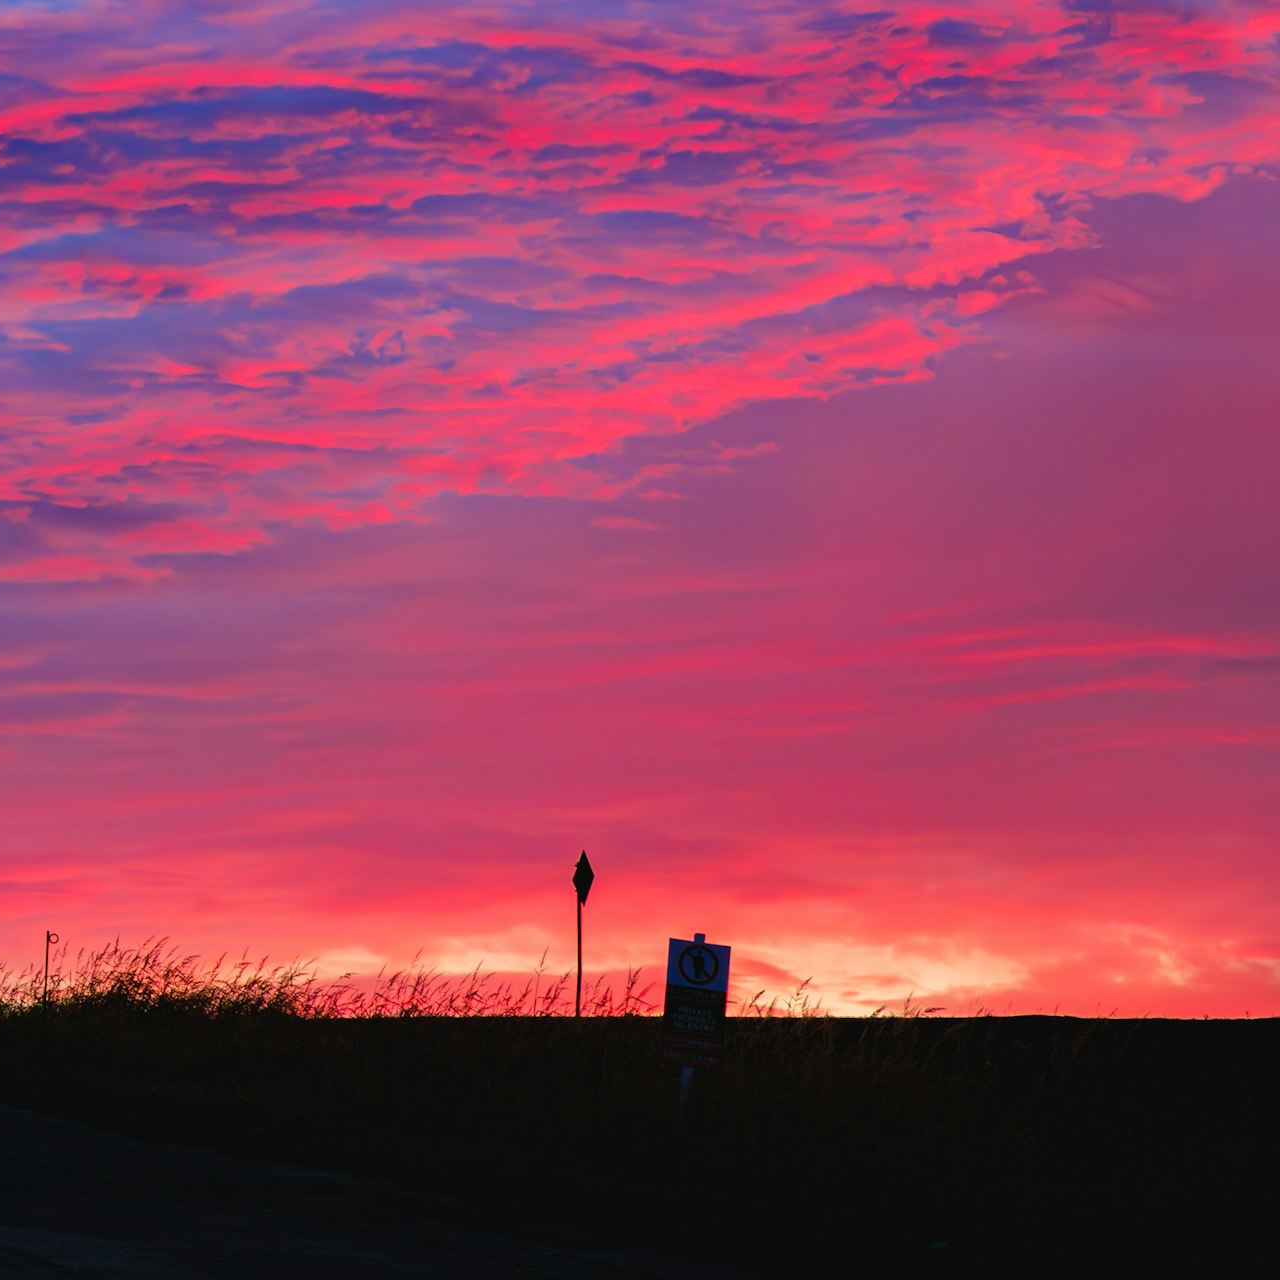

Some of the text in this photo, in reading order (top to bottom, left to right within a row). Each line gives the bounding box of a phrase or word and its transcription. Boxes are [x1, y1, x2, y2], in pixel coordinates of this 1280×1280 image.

[678, 1007, 712, 1017] PRIVATE
[673, 1014, 716, 1025] PROPERTY
[673, 1021, 714, 1032] NO ENTRY
